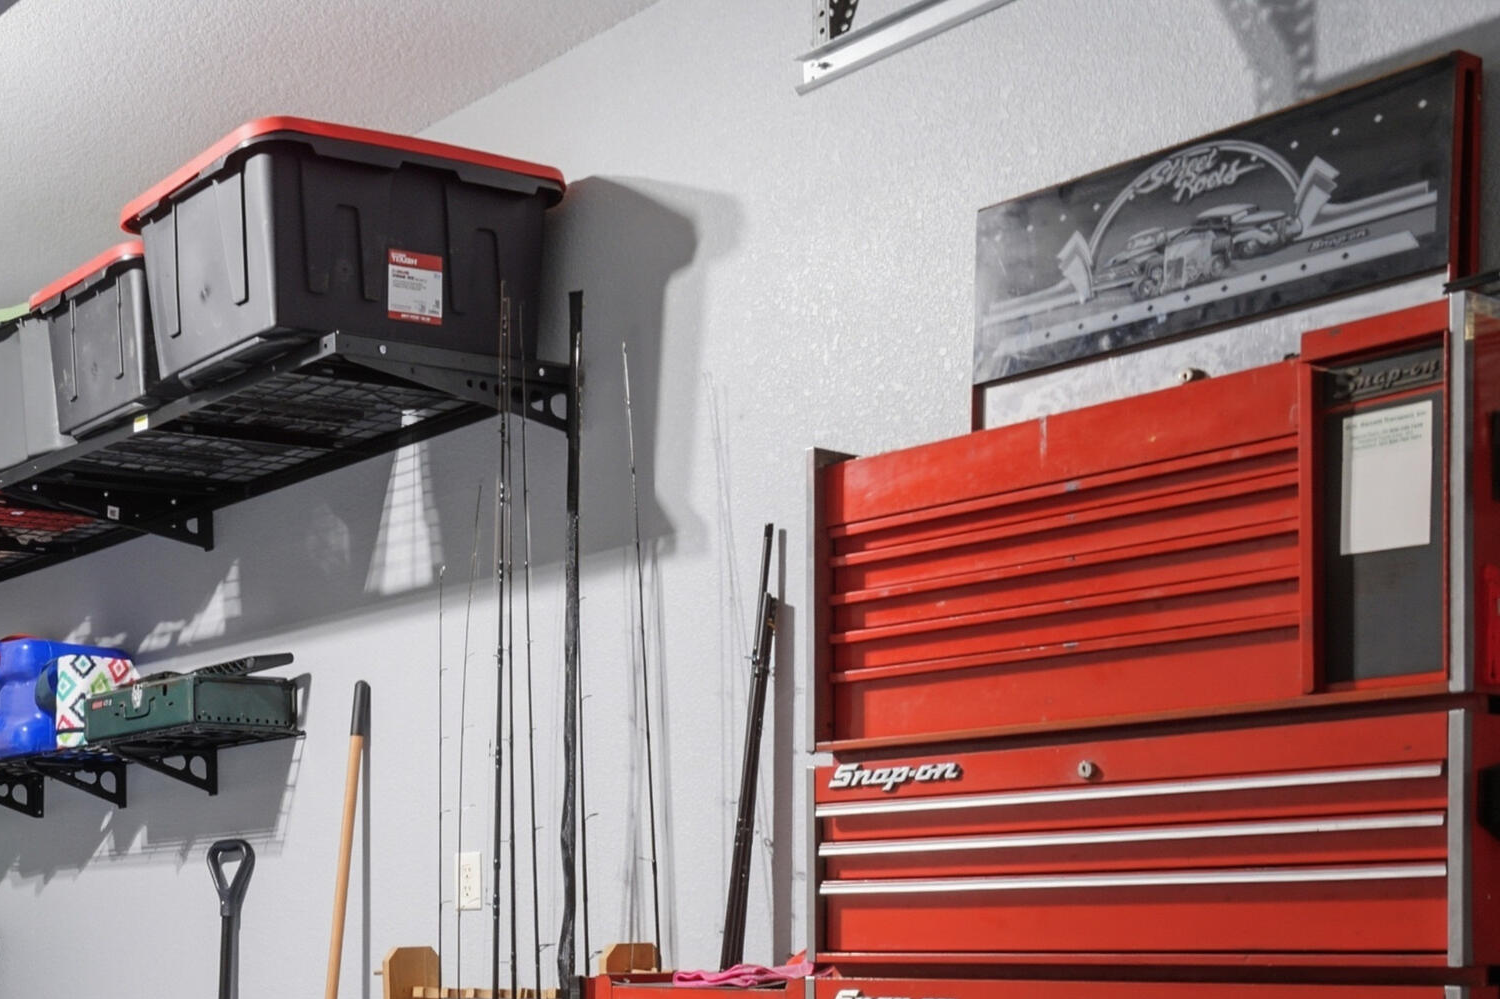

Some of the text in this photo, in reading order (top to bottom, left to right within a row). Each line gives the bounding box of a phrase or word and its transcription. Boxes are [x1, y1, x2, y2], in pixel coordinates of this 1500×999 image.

[1135, 149, 1218, 193] Street
[1173, 159, 1264, 202] Rods
[1333, 360, 1440, 399] Snap-on
[828, 762, 960, 792] Snap-on
